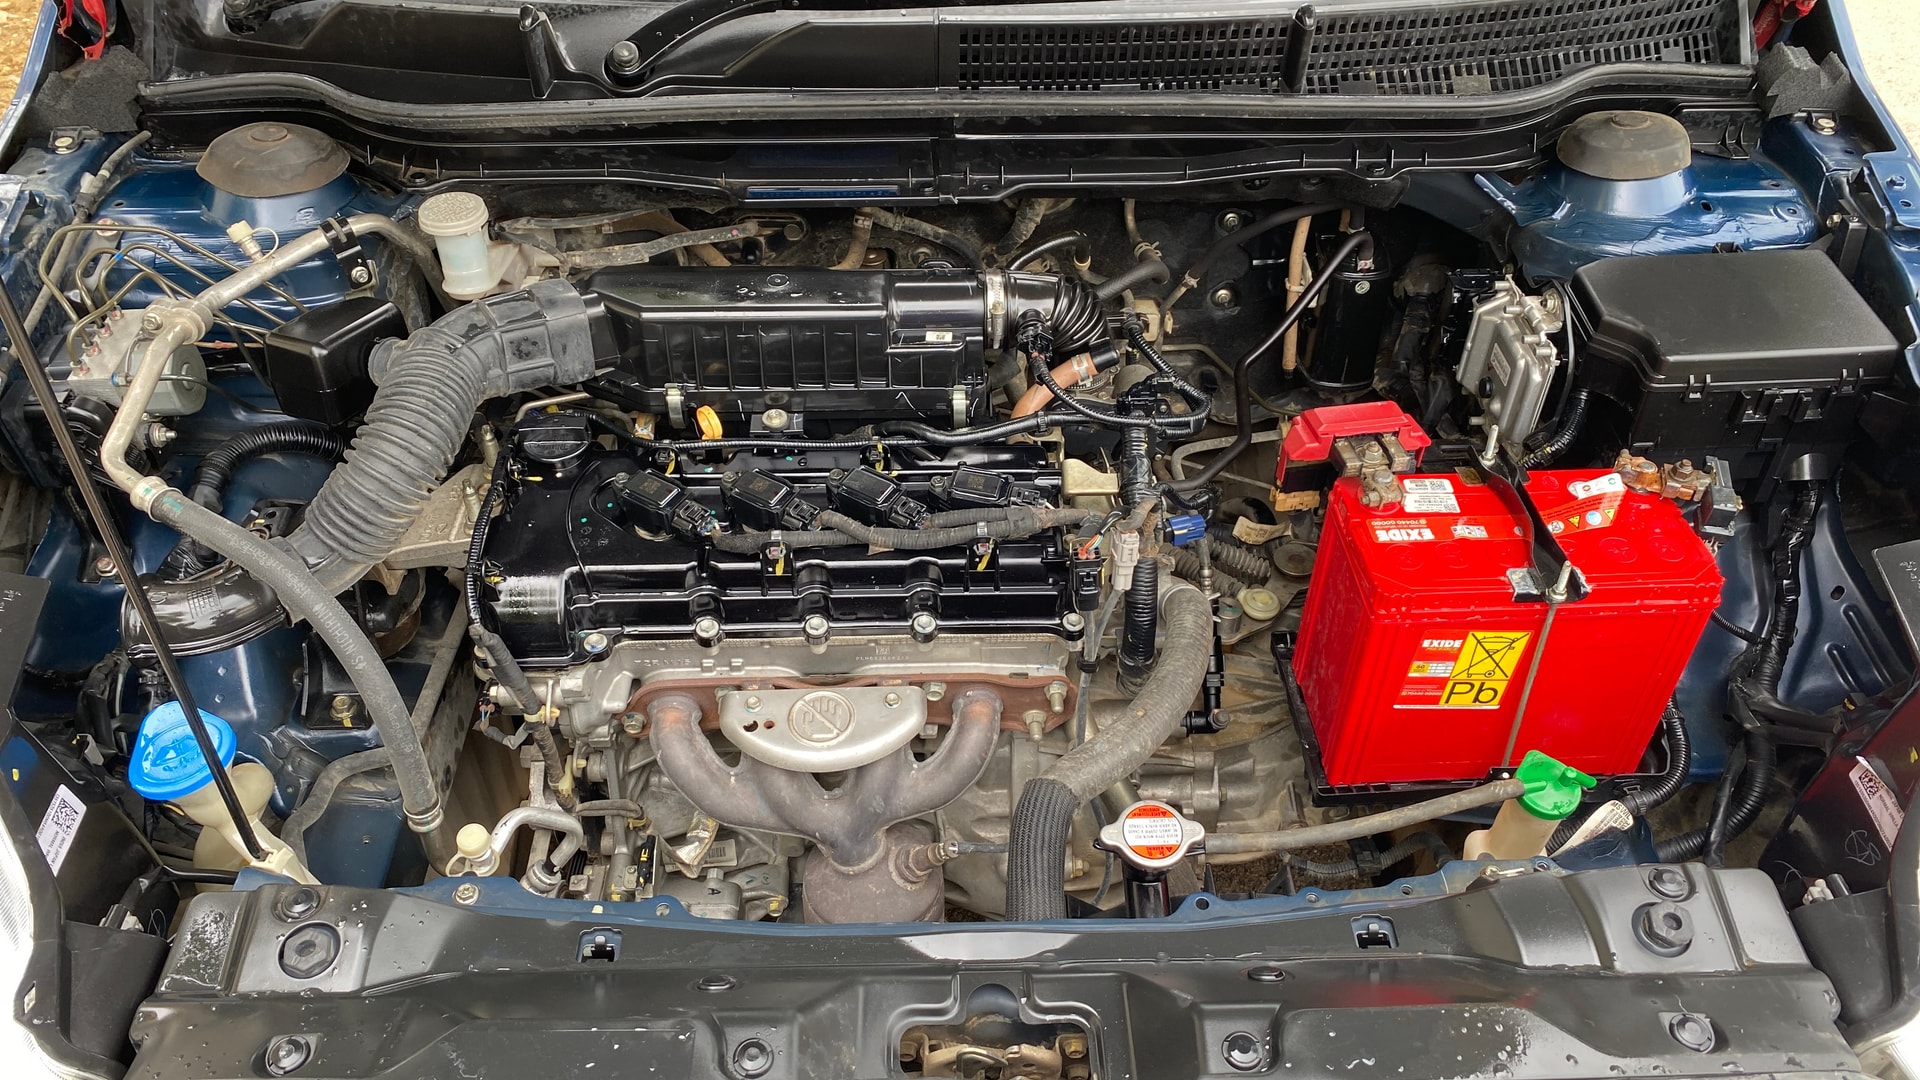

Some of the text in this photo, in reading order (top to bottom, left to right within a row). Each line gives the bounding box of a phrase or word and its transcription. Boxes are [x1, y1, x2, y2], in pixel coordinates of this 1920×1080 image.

[1375, 528, 1435, 541] EXIDE
[1421, 639, 1463, 648] EXIDE
[1444, 681, 1498, 704] Pb
